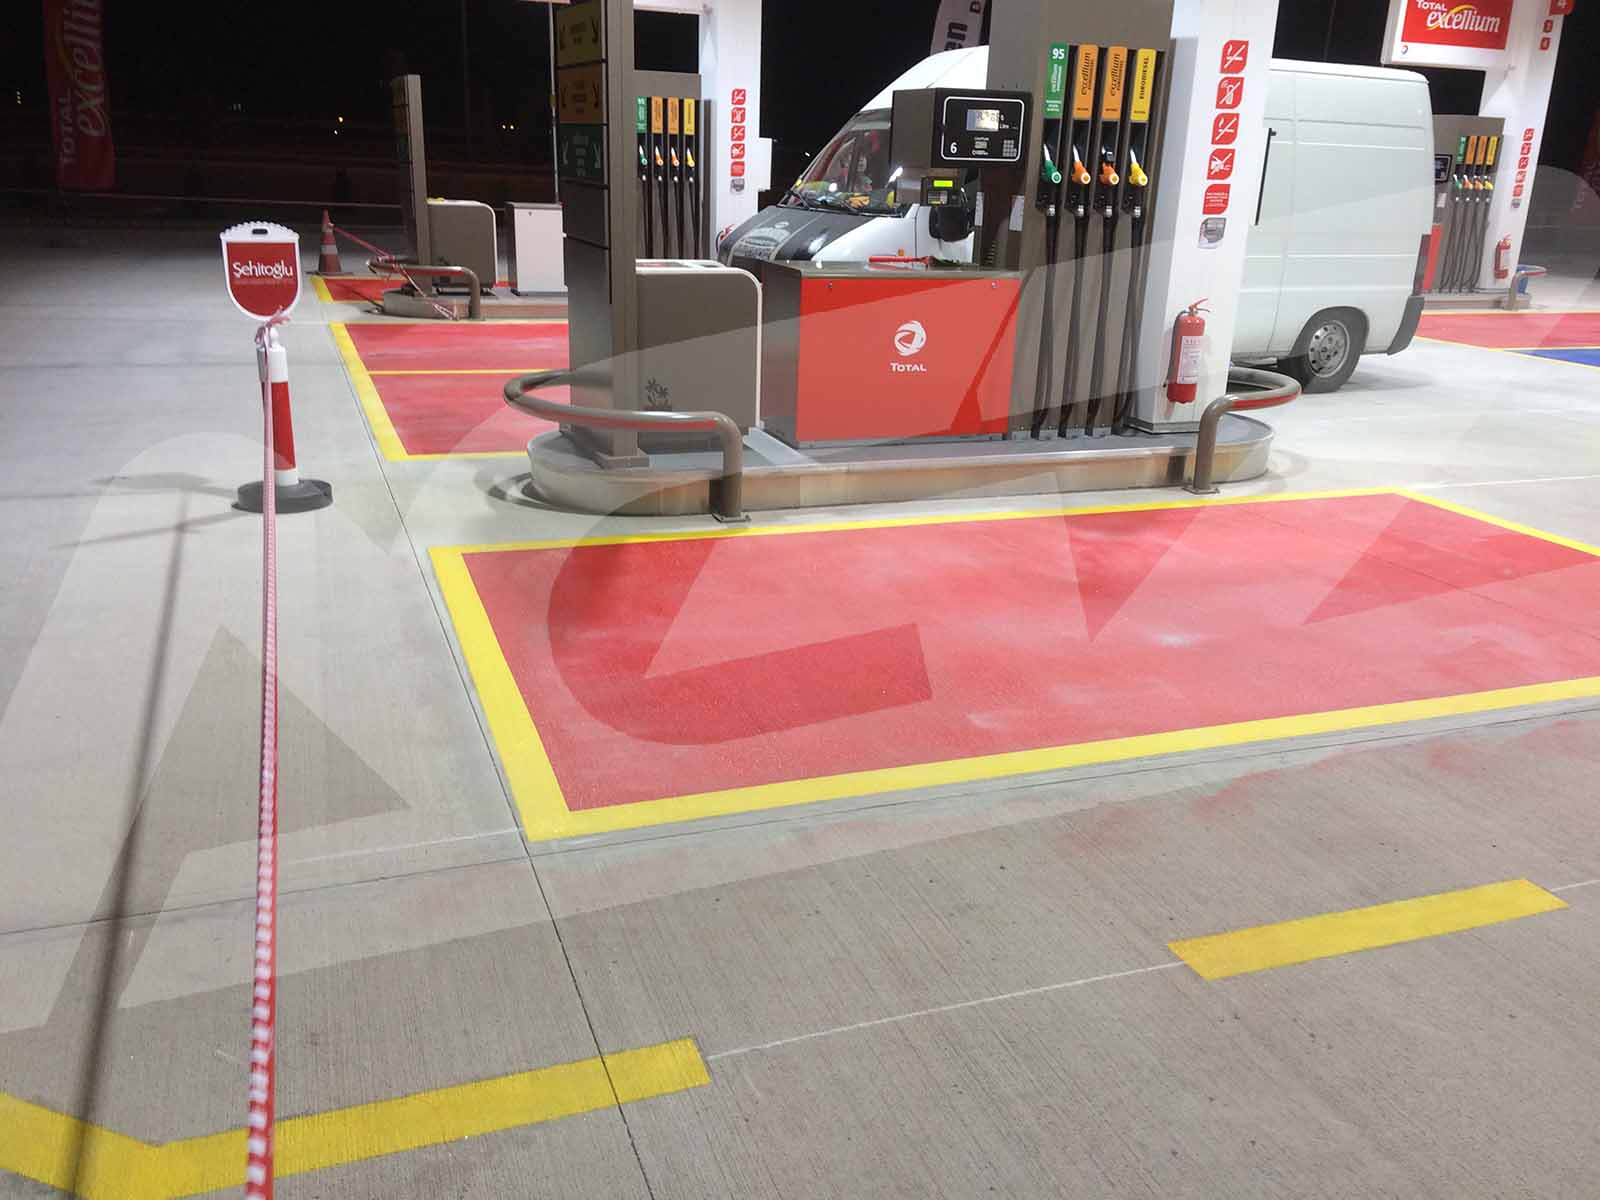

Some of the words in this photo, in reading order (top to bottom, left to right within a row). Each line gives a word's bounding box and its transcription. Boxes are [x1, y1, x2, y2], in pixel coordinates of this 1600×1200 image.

[1416, 0, 1448, 12] TOTAL
[1426, 9, 1501, 33] excellium
[1051, 47, 1065, 60] 95
[1080, 52, 1092, 96] excellium
[1109, 54, 1121, 97] excellium
[57, 88, 77, 165] TOTAL
[950, 142, 958, 154] 6
[890, 362, 927, 372] TOTAL
